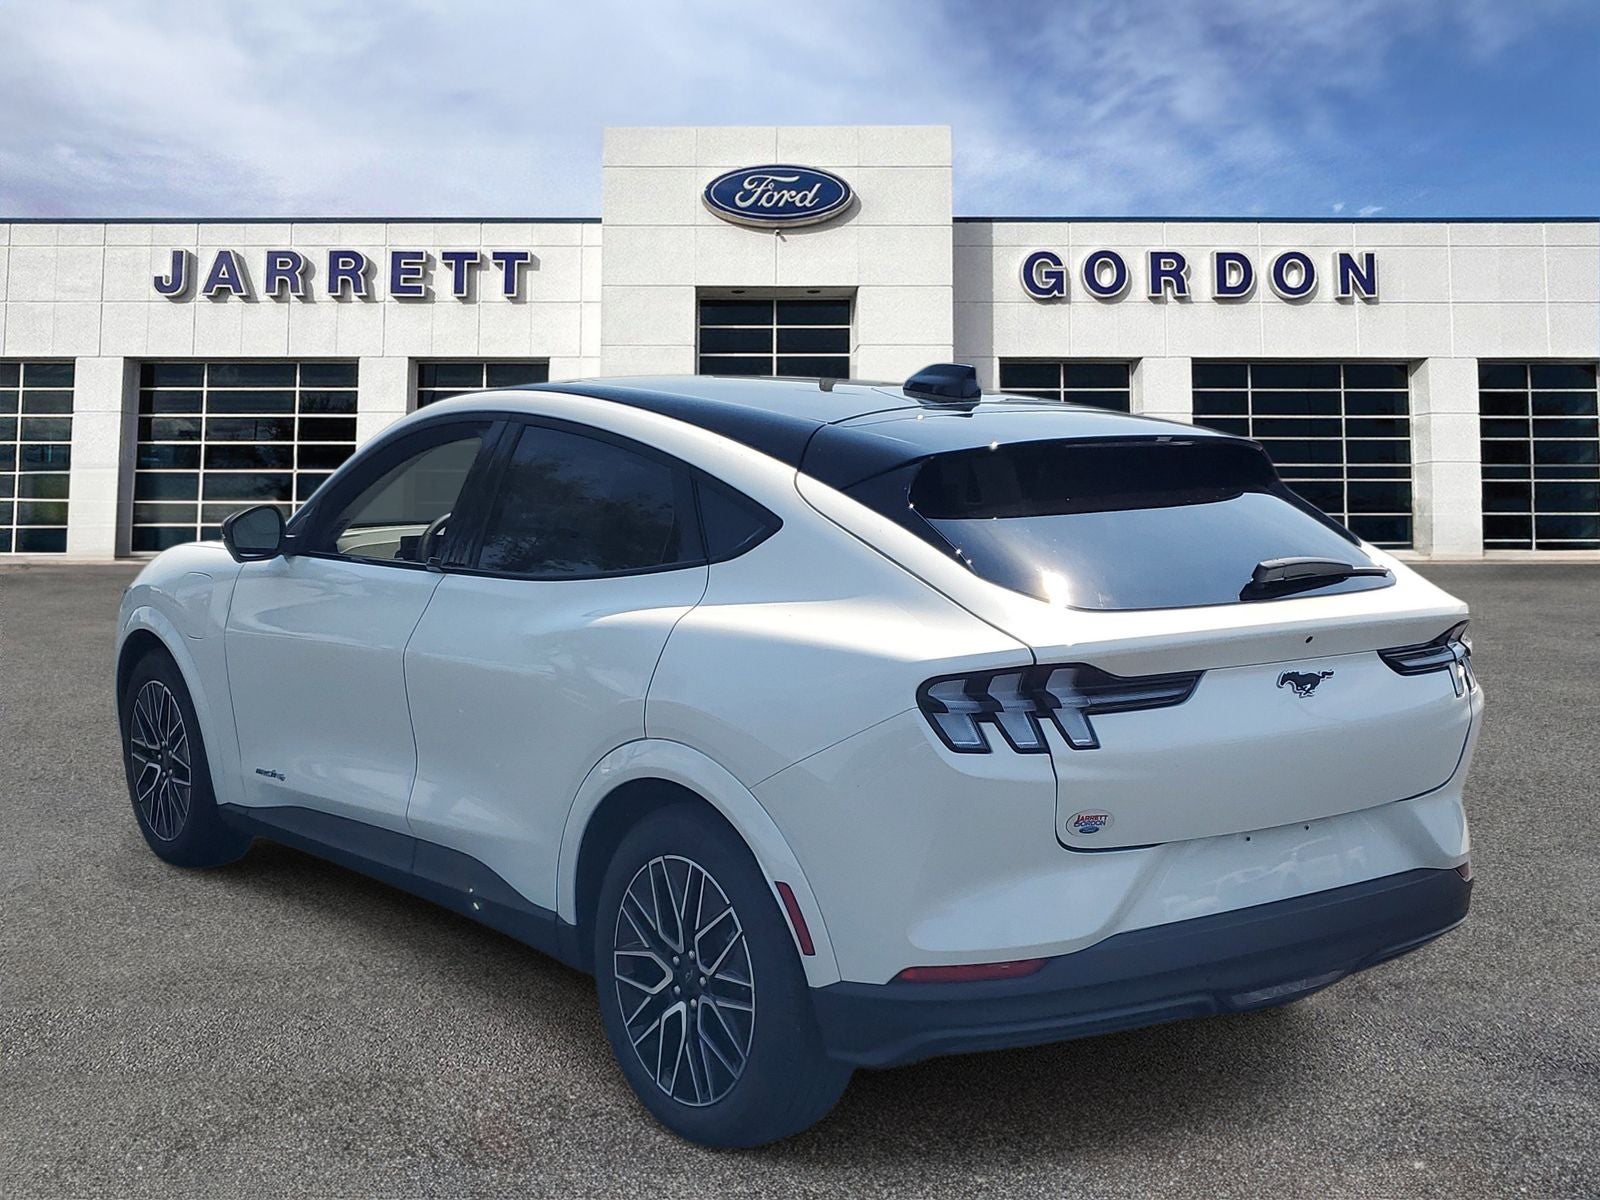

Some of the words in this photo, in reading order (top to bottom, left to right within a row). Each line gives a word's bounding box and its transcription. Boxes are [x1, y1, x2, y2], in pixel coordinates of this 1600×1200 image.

[735, 174, 822, 208] Ford
[153, 248, 531, 297] JARRETT
[1021, 249, 1379, 299] GORDON
